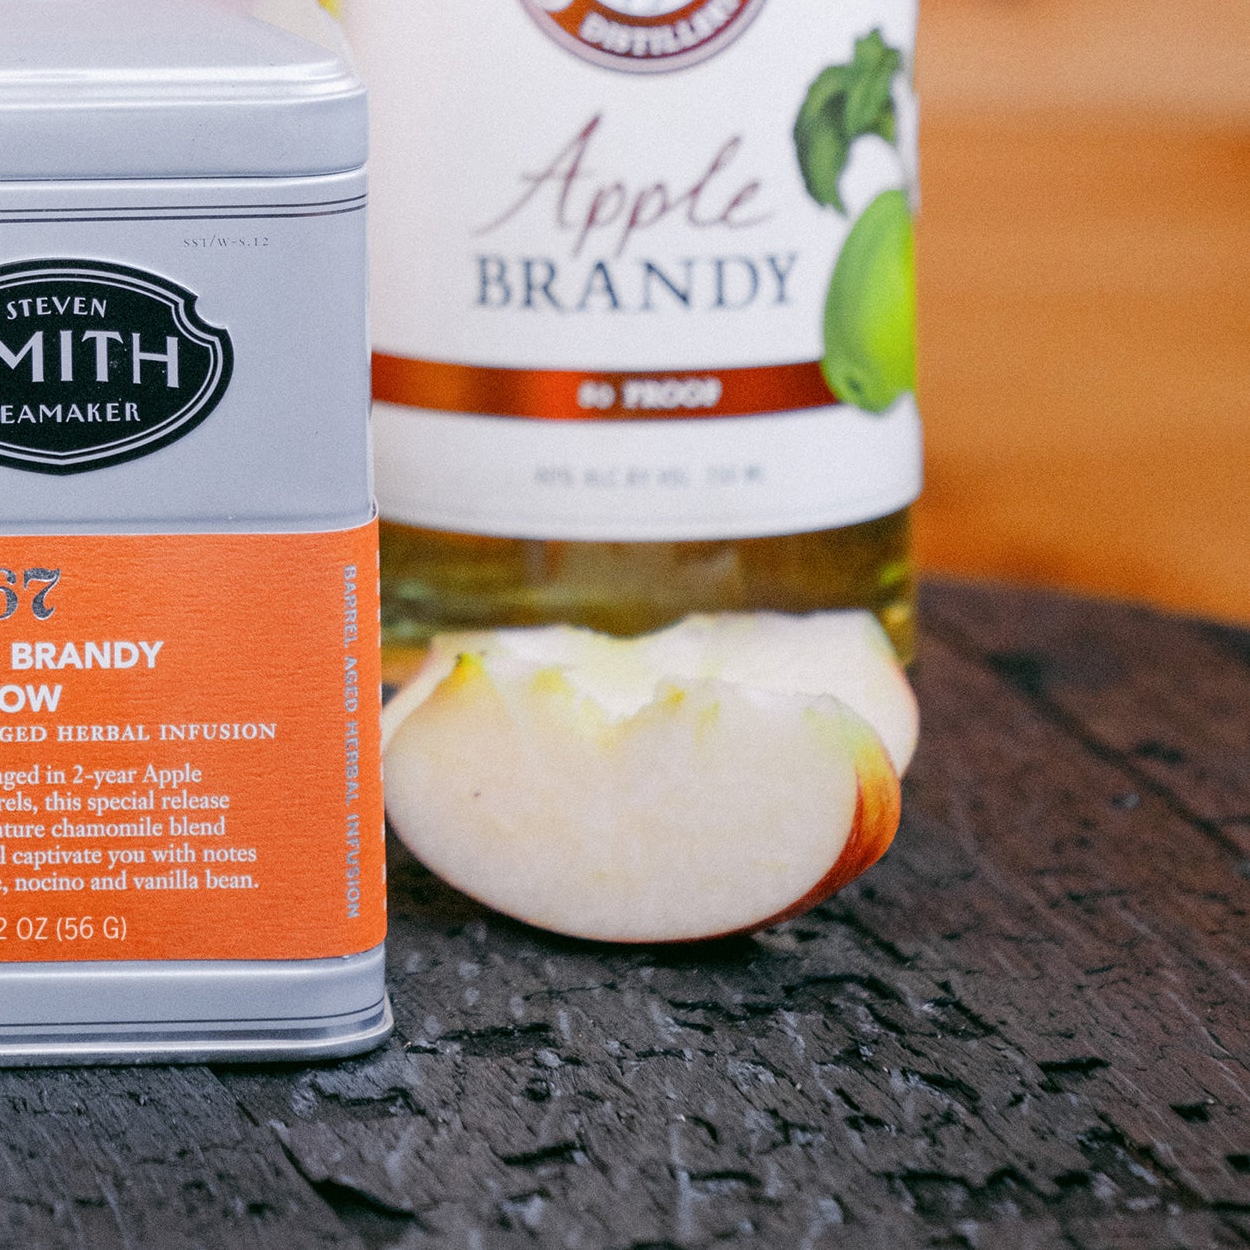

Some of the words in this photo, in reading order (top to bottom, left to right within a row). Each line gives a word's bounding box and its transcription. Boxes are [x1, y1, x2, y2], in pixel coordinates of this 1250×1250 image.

[471, 112, 776, 258] Apple
[473, 252, 799, 313] BRANDY
[6, 296, 108, 321] STEVEN
[344, 564, 358, 648] BARREL
[11, 640, 165, 670] BRANDY
[344, 655, 358, 712] AGED
[56, 724, 150, 742] HERBAL
[159, 723, 278, 741] INFUSION
[46, 764, 66, 784] in
[72, 765, 137, 789] 2-year
[141, 762, 202, 788] Apple
[345, 720, 359, 807] HERBAL
[44, 791, 81, 811] this
[87, 790, 154, 816] special
[161, 790, 230, 810] release
[51, 817, 163, 837] chamomile
[169, 816, 226, 836] blend
[11, 845, 102, 870] captivate
[107, 849, 146, 870] you
[151, 843, 196, 863] with
[202, 845, 257, 863] notes
[346, 813, 360, 919] INFUSION
[14, 872, 85, 892] nocino
[90, 870, 128, 891] and
[132, 869, 199, 890] vanilla
[204, 868, 260, 890] bean.
[16, 916, 49, 940] OZ
[55, 915, 94, 941] (56
[102, 915, 127, 941] G)
